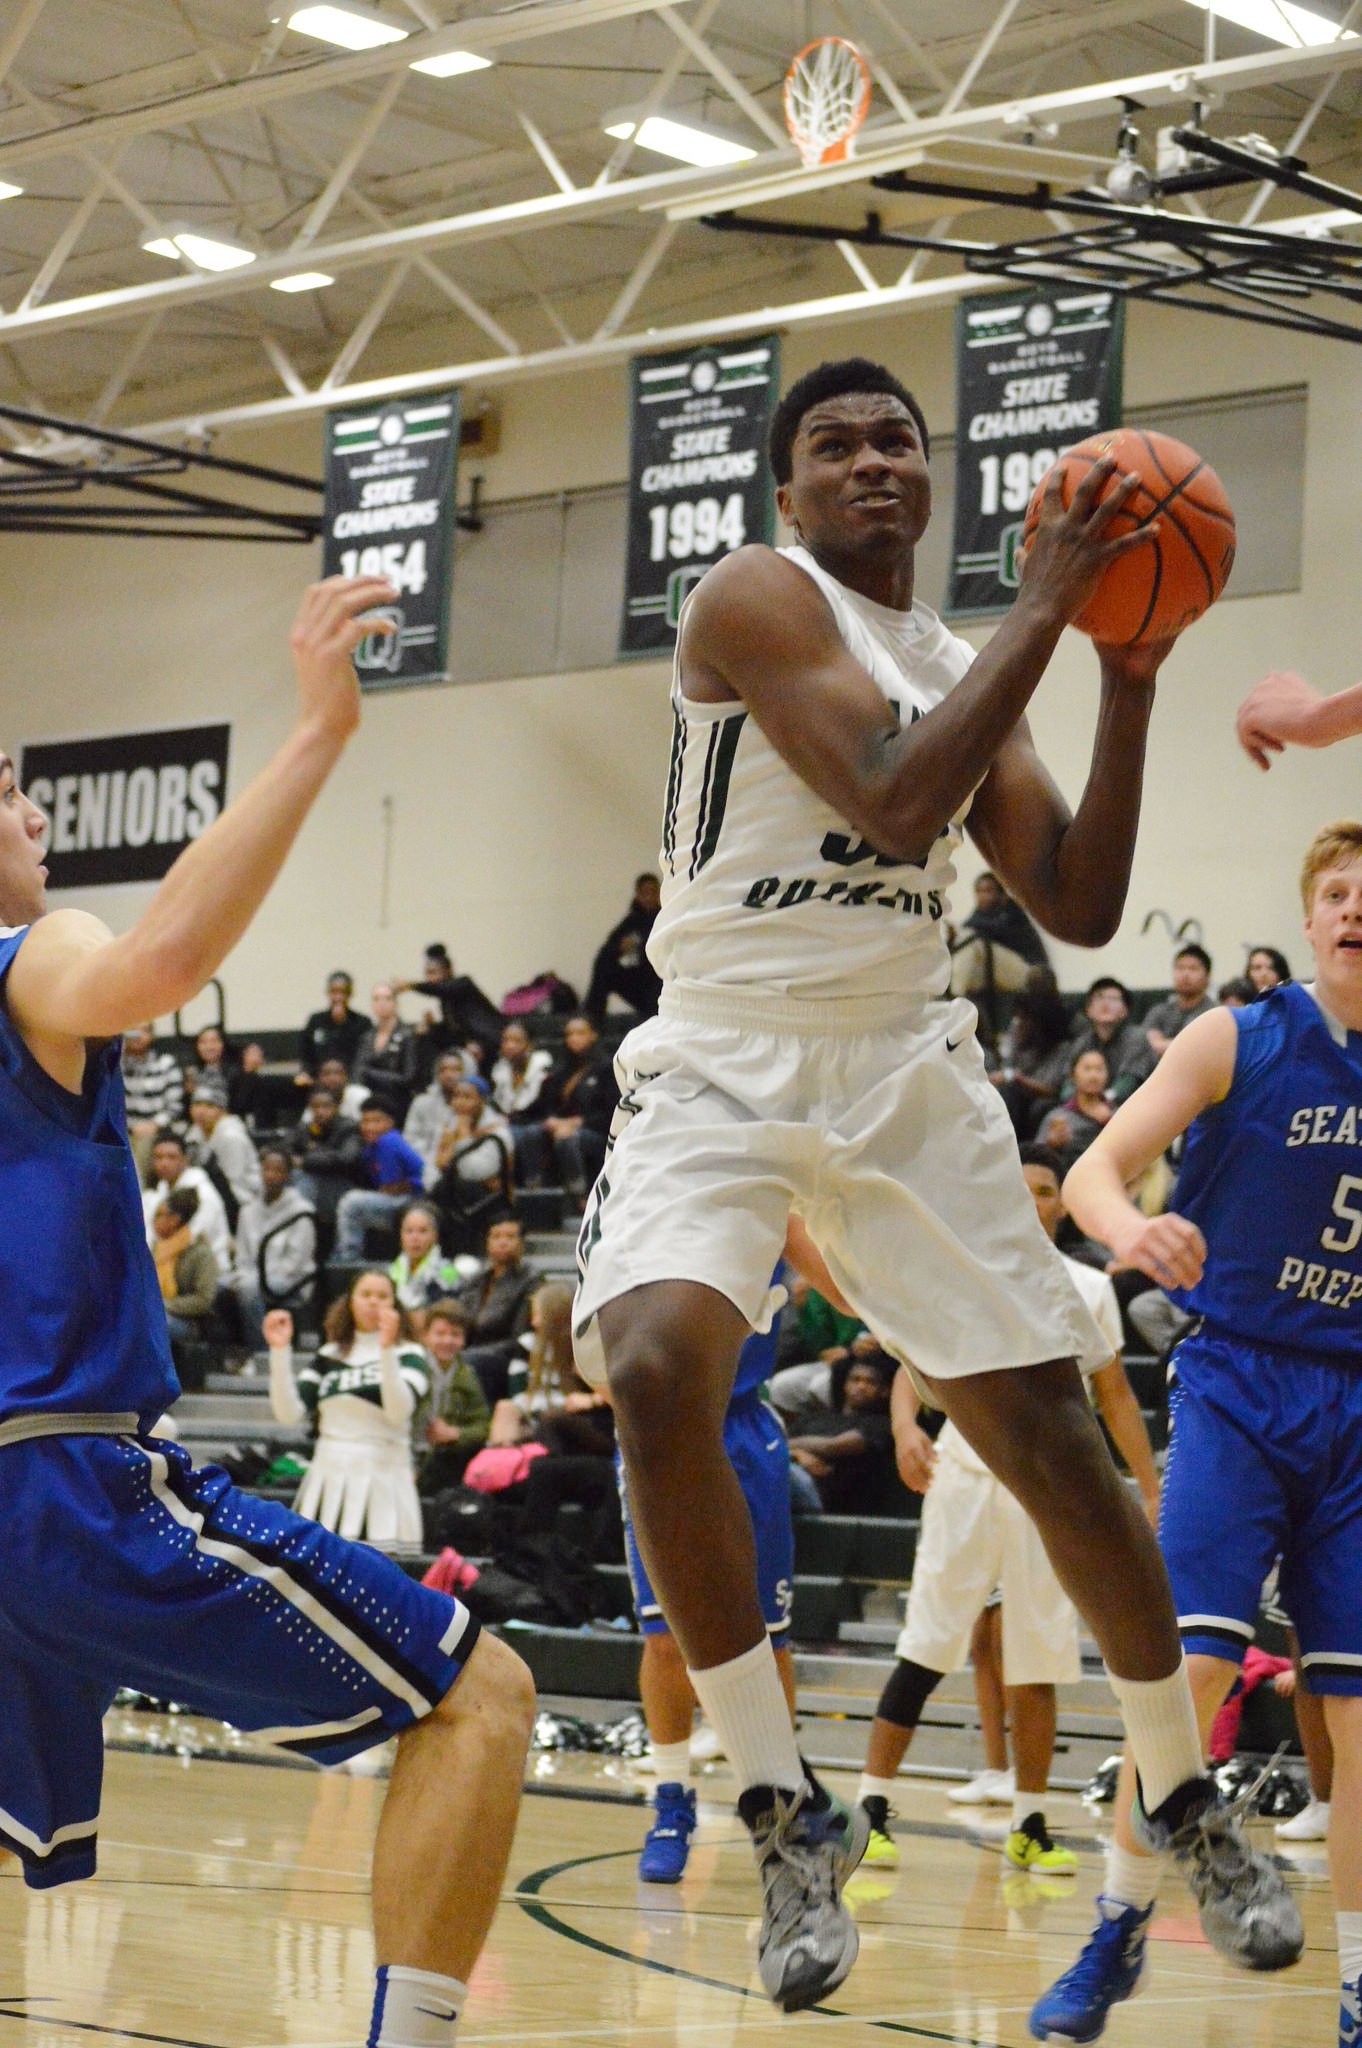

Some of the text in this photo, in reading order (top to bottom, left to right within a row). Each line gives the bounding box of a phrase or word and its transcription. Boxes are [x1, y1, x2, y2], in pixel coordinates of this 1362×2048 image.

[1002, 372, 1071, 408] STATE
[969, 398, 1100, 442] CHAMPIONS
[670, 425, 733, 460] STATE
[360, 475, 417, 508] STATE
[641, 449, 758, 492] CHAMPIONS
[979, 445, 1076, 516] 199
[333, 499, 440, 539] CHAMPIONS
[649, 493, 746, 562] 1994
[26, 760, 220, 853] SENIORS
[1286, 1105, 1362, 1147] SEA
[1276, 1256, 1362, 1309] PREP
